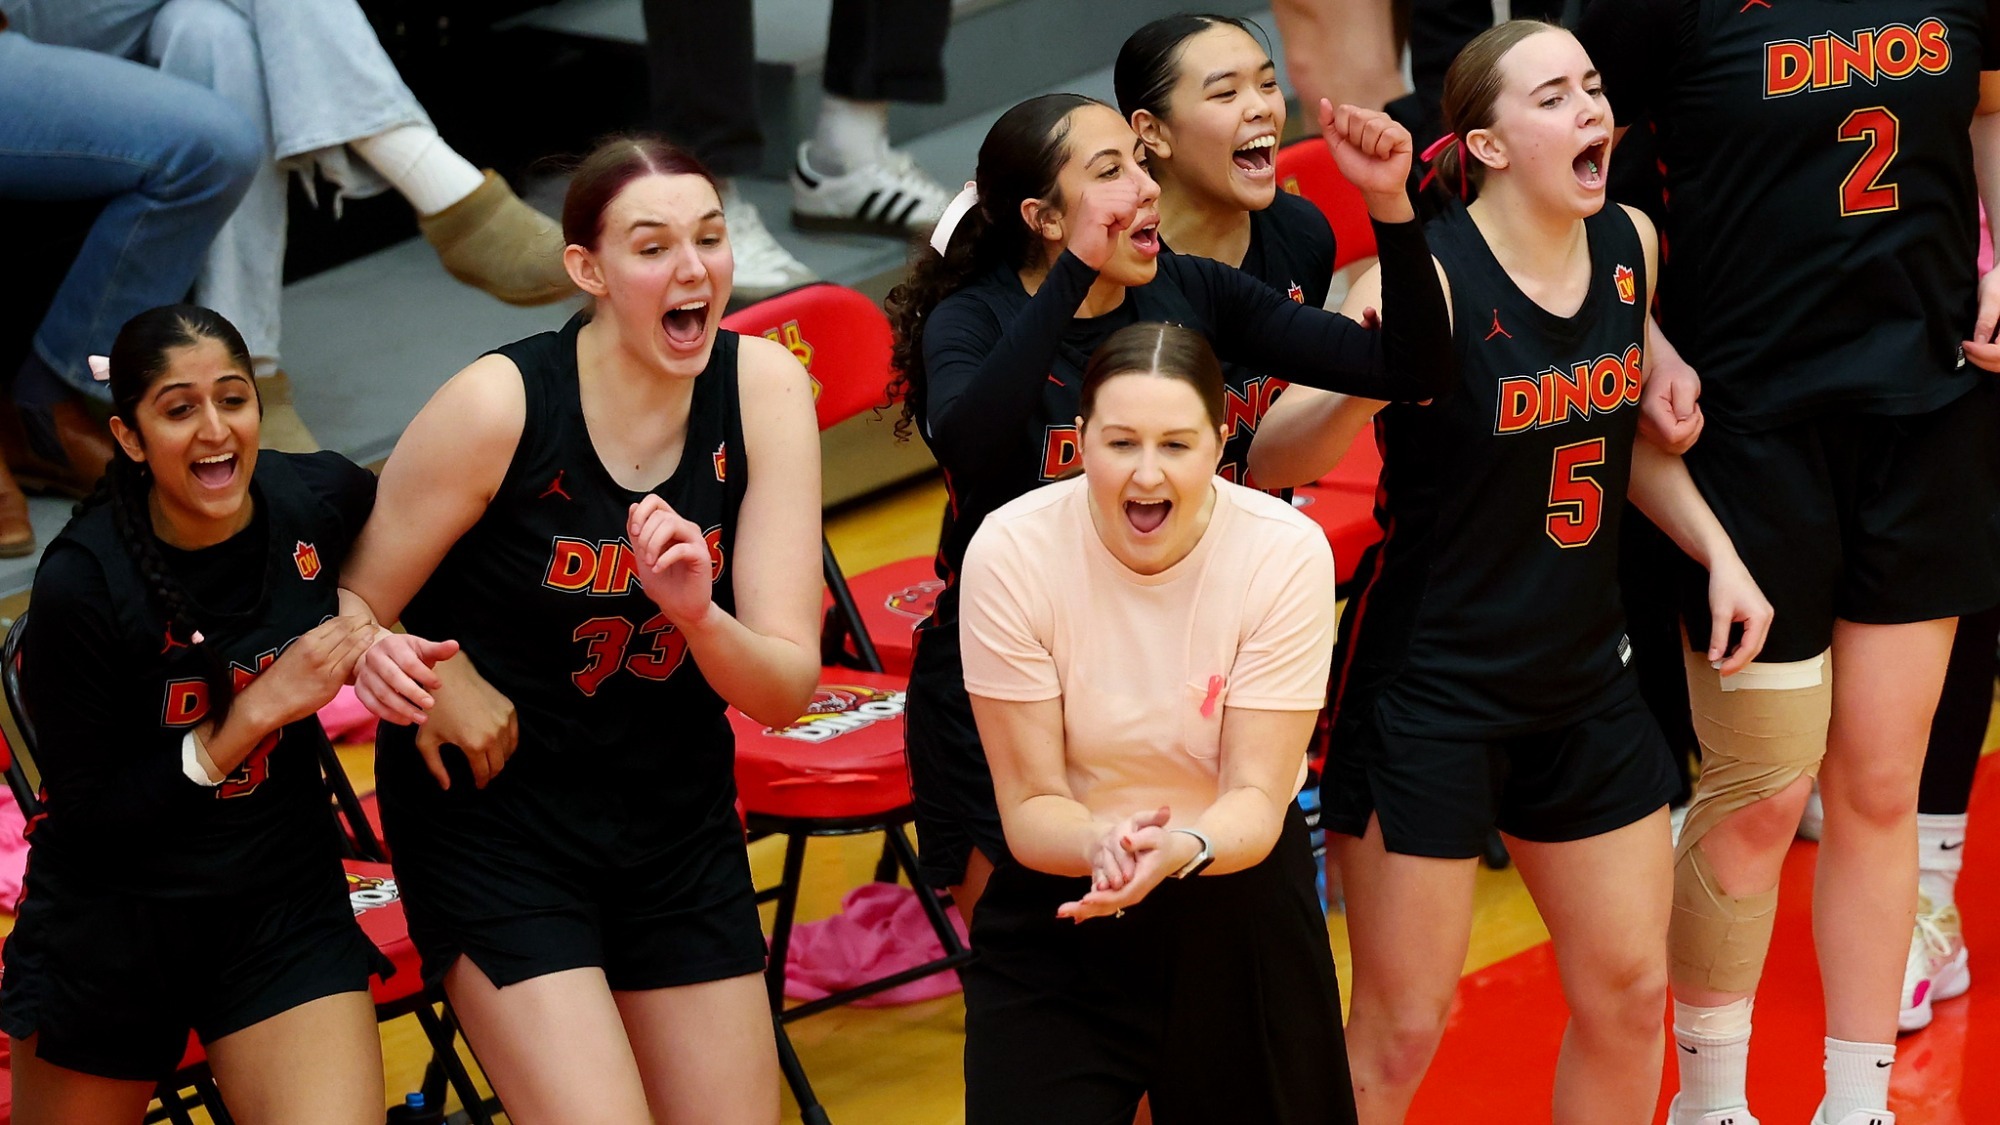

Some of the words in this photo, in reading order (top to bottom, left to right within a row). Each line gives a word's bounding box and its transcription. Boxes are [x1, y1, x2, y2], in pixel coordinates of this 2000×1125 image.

[1763, 17, 1952, 100] DINOS
[1838, 105, 1899, 217] 2
[1494, 343, 1642, 435] DINOS
[1546, 437, 1605, 548] 5
[542, 524, 725, 596] DINS
[571, 611, 690, 697] 33
